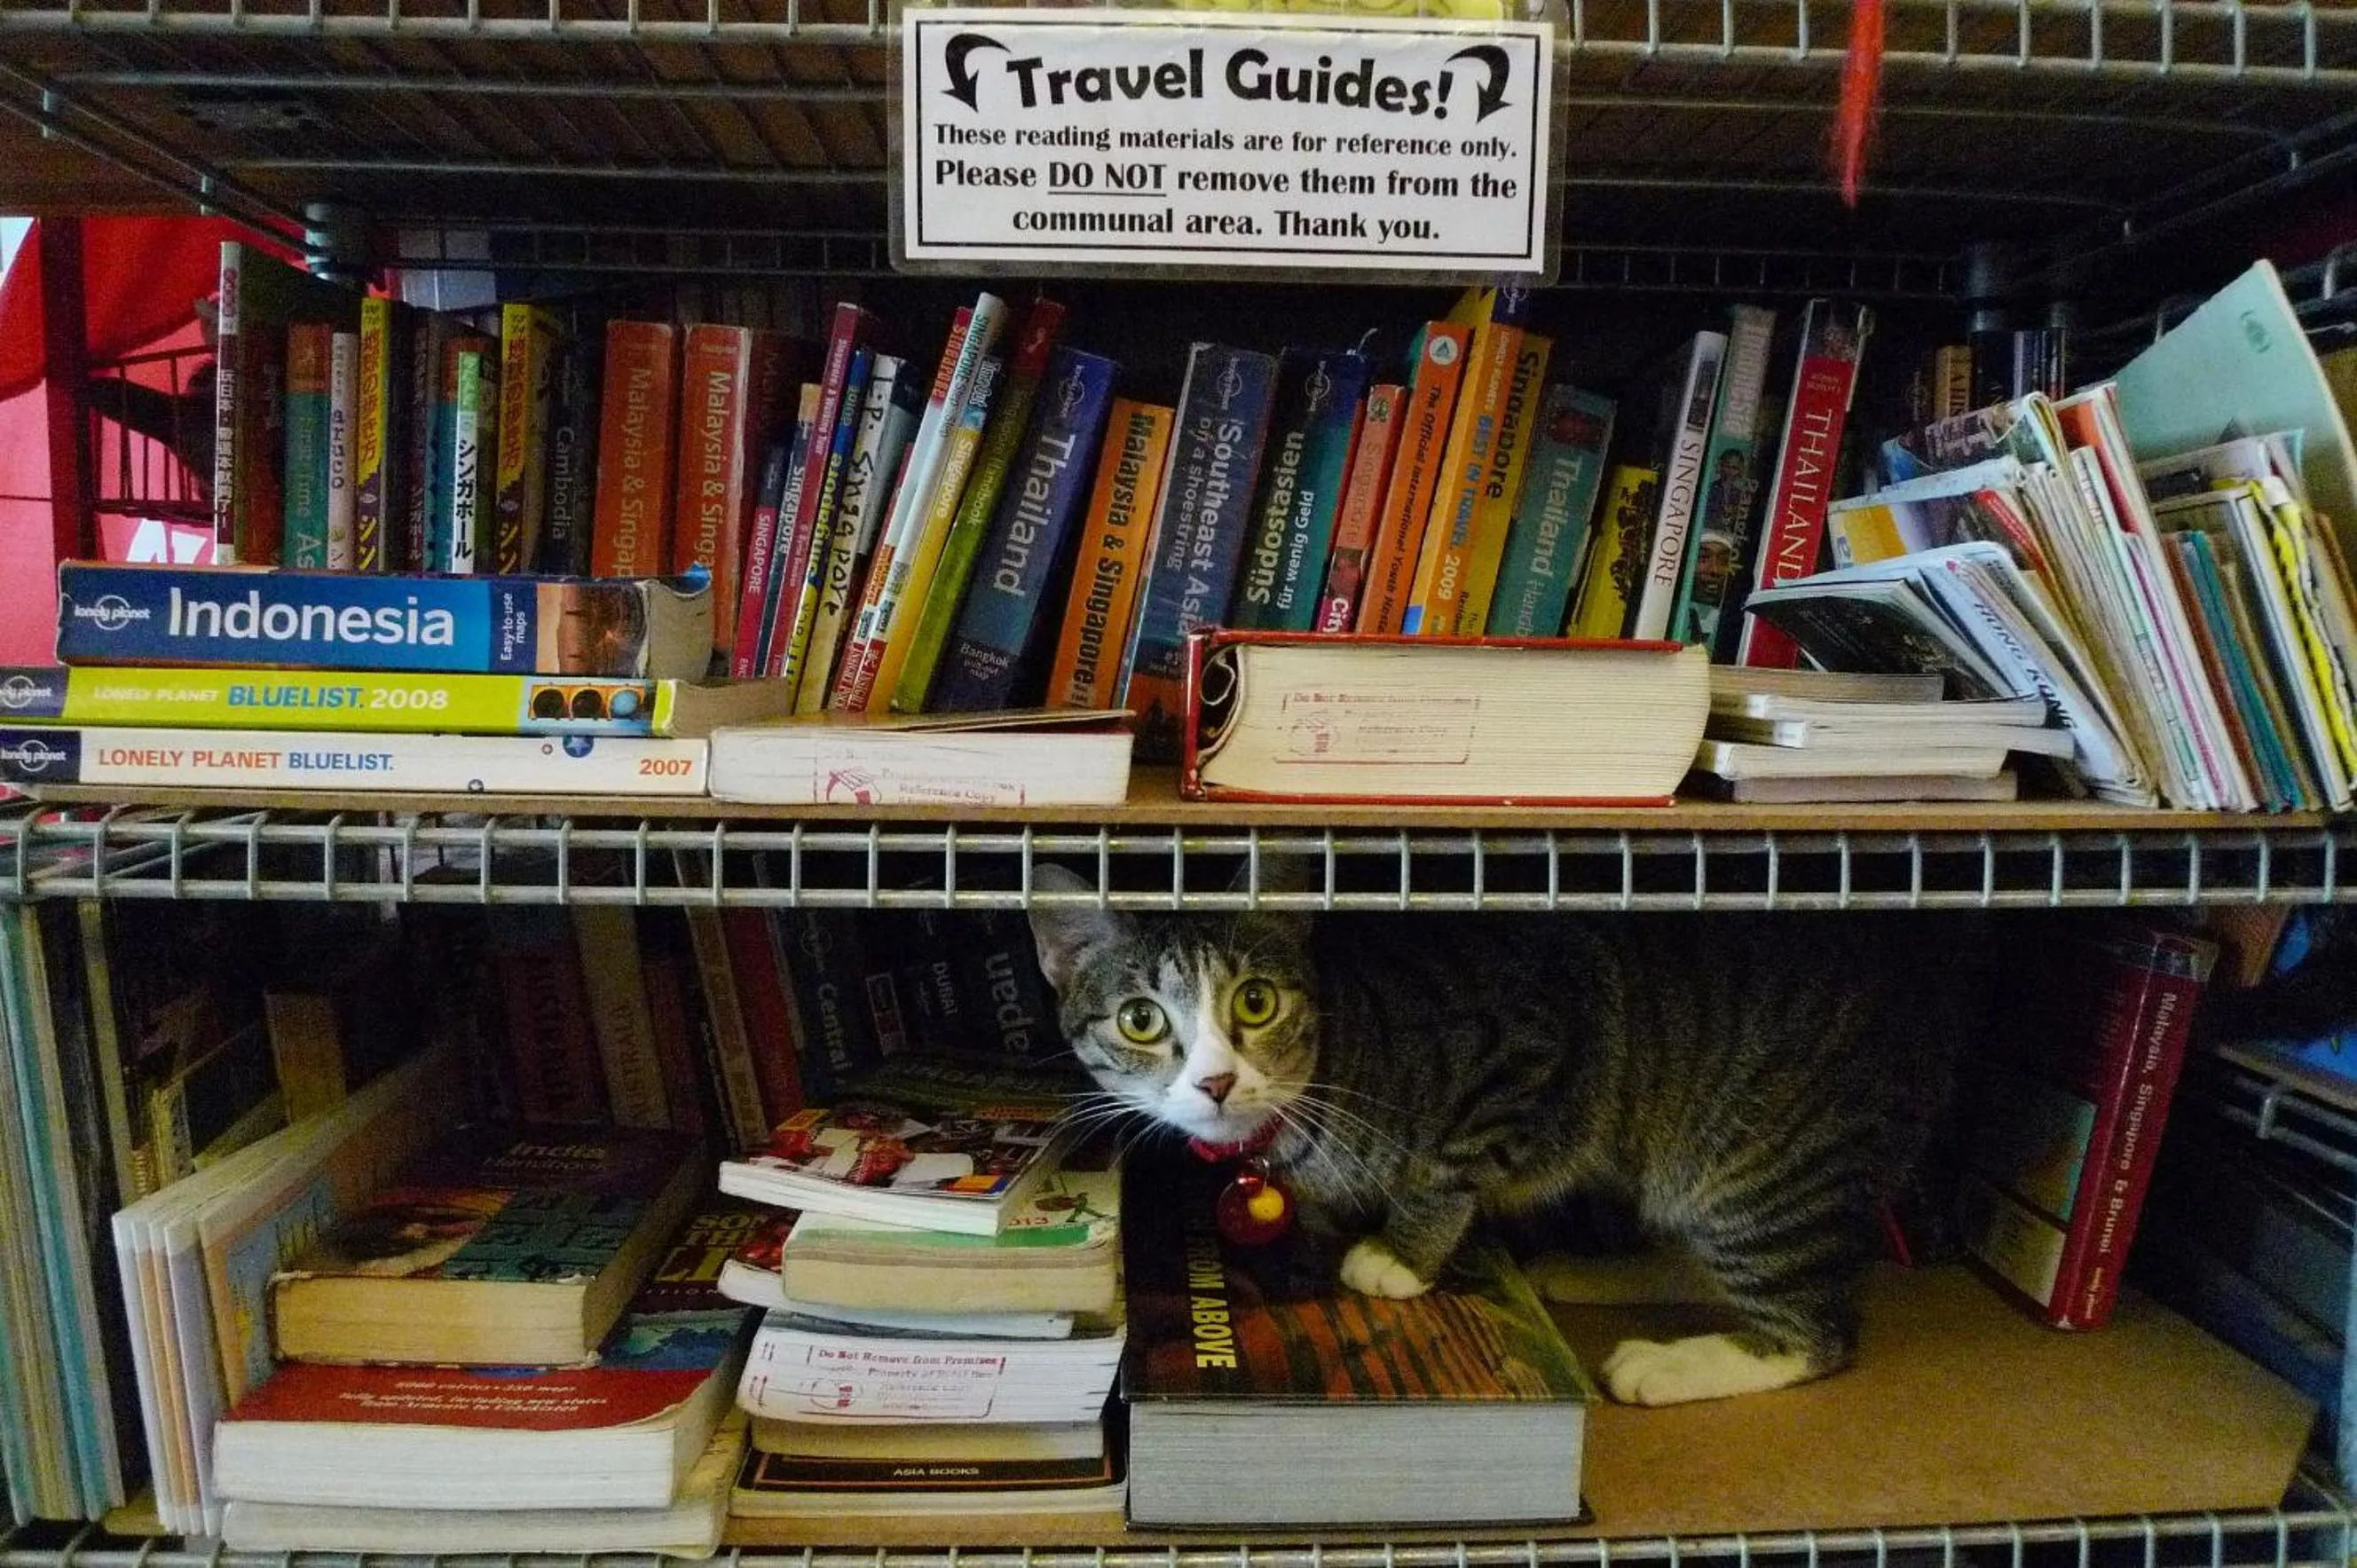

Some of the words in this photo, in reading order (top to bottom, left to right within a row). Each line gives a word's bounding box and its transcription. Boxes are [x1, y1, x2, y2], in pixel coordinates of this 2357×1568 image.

[1007, 49, 1204, 108] Travel
[1226, 47, 1454, 120] Guides!
[934, 123, 1006, 146] These
[1015, 126, 1111, 152] reading
[1120, 127, 1234, 151] materials
[1243, 136, 1283, 153] are
[1292, 131, 1327, 154] for
[1336, 132, 1452, 157] reference
[1461, 136, 1517, 161] only.
[936, 160, 1037, 188] Please
[1048, 162, 1094, 189] DO
[1105, 163, 1167, 190] NOT
[1178, 171, 1290, 193] remove
[1300, 169, 1376, 195] them
[1387, 170, 1459, 198] from
[1470, 172, 1517, 200] the
[1013, 209, 1173, 234] communal
[1186, 215, 1262, 237] area.
[1273, 210, 1368, 239] Thank
[1377, 217, 1440, 243] you.
[954, 312, 989, 382] SINGAPORE
[622, 369, 653, 473] Malaysia
[702, 370, 733, 478] Malaysia
[1194, 416, 1210, 444] on
[1413, 411, 1436, 462] Official
[453, 437, 477, 560] シンガポール
[551, 426, 576, 540] Cambodia
[623, 478, 646, 492] &
[701, 482, 725, 498] &
[933, 435, 974, 521] Singapore
[965, 454, 1005, 530] Handbook
[1107, 412, 1155, 528] Malaysia
[1190, 418, 1243, 572] Southeast
[1772, 407, 1833, 582] THAILAND
[696, 500, 724, 571] Singa
[779, 465, 806, 555] Singapore
[993, 433, 1076, 597] Thailand
[1101, 534, 1124, 551] &
[1167, 464, 1203, 572] shoestring
[1245, 430, 1305, 606] Südostasien
[1294, 490, 1315, 530] Geld
[1392, 465, 1423, 553] International
[1527, 451, 1583, 578] Thailand
[1653, 437, 1700, 588] SINGAPORE
[748, 512, 771, 595] SINGAPORE
[1282, 532, 1310, 583] wenig
[1384, 553, 1404, 594] Youth
[1434, 553, 1462, 601] 2009
[74, 603, 112, 621] lonely
[111, 605, 151, 620] planet
[169, 587, 455, 646] Indonesia
[499, 591, 515, 662] Easy-to-use
[513, 611, 528, 646] maps
[1073, 557, 1123, 687] Singapore
[1275, 582, 1293, 611] für
[1321, 595, 1349, 634] City
[960, 642, 1011, 669] Bangkok
[1973, 603, 2025, 661] HONG
[94, 686, 150, 702] LONELY
[157, 688, 220, 703] PLANET
[370, 687, 449, 711] 2008
[99, 749, 184, 768] LONELY
[191, 751, 282, 770] PLANET
[639, 758, 693, 776] 2007
[974, 948, 1043, 1057] apan
[2115, 1080, 2155, 1171] Singapore
[2096, 1195, 2125, 1255] Brunei
[863, 1351, 909, 1365] Remove
[1190, 1295, 1238, 1368] ABOVE
[893, 1465, 928, 1477] ASIA
[929, 1465, 980, 1478] BOOKS
